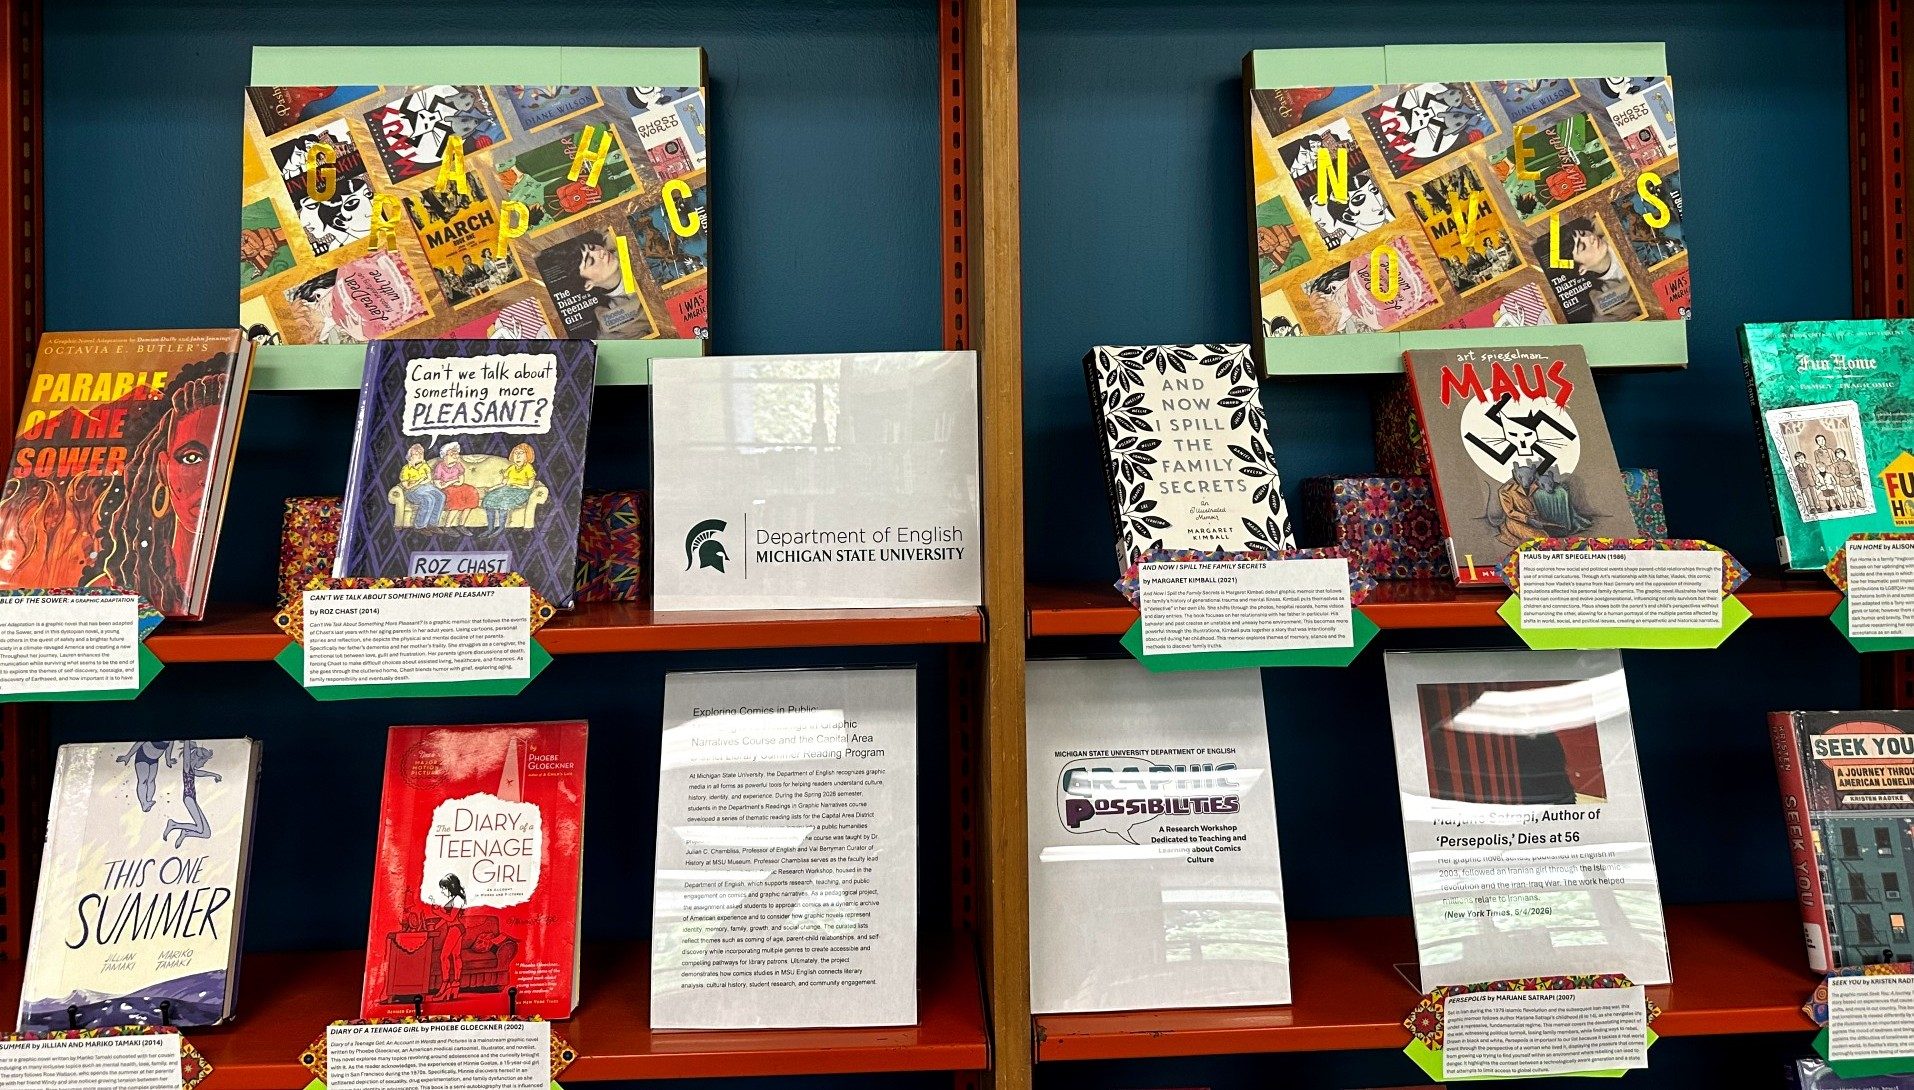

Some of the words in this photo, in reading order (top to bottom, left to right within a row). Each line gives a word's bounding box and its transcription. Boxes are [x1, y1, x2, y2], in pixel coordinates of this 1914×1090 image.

[637, 113, 676, 133] GHOST
[640, 120, 679, 139] WORLD
[425, 209, 495, 249] MARCH
[553, 288, 571, 301] The
[558, 295, 582, 310] Diary
[560, 296, 599, 317] Teenage
[564, 313, 583, 326] Girl
[44, 345, 109, 355] OCTAVIA
[115, 344, 129, 354] E.
[137, 343, 209, 353] BUTLER'S
[1456, 350, 1475, 362] art
[1480, 348, 1549, 362] spiegelman
[1795, 353, 1831, 373] Fun
[1830, 353, 1878, 373] Home
[411, 362, 453, 381] Can't
[458, 371, 476, 380] we
[481, 361, 510, 380] talk
[514, 361, 553, 380] about
[31, 371, 169, 403] PARABLE
[1161, 378, 1205, 391] AND
[1440, 359, 1575, 409] MAUS
[413, 382, 489, 401] something
[499, 385, 535, 397] more
[1161, 398, 1211, 411] NOW
[411, 397, 548, 427] PLEASANT?
[22, 409, 66, 440] OF
[70, 408, 128, 440] THE
[1156, 419, 1161, 432] I
[1170, 418, 1225, 431] SPILL
[1173, 438, 1213, 452] THE
[13, 446, 128, 479] SOWER
[1162, 458, 1234, 474] FAMILY
[1159, 479, 1247, 495] SECRETS
[756, 529, 867, 548] Department
[872, 526, 891, 544] of
[898, 525, 963, 545] English
[1883, 543, 1891, 551] by
[756, 549, 833, 564] MICHIGAN
[836, 548, 876, 562] STATE
[880, 547, 965, 562] UNIVERSITY
[1542, 553, 1551, 561] by
[414, 557, 453, 575] ROZ
[457, 557, 506, 574] CHAST
[1142, 563, 1157, 571] AND
[1237, 562, 1267, 570] SECRETS
[1142, 578, 1151, 586] by
[1217, 576, 1238, 584] (2021)
[387, 592, 431, 600] SOMETHING
[454, 590, 495, 598] PLEASANT?
[309, 608, 319, 616] by
[358, 607, 380, 616] (2014)
[851, 733, 874, 743] Area
[1054, 750, 1088, 758] MICHIGAN
[1110, 749, 1150, 757] UNIVERSITY
[1150, 748, 1195, 756] DEPARTMENT
[1814, 737, 1869, 757] SEEK
[1871, 736, 1914, 756] YOU
[527, 754, 560, 762] PHOEBE
[845, 748, 885, 760] Program
[527, 761, 575, 770] GLOECKNER
[1837, 768, 1844, 777] A
[1845, 767, 1885, 777] JOURNEY
[1839, 778, 1880, 787] AMERICAN
[436, 824, 451, 833] The
[454, 808, 523, 833] DIARY
[1541, 810, 1586, 822] Author
[1588, 808, 1601, 820] of
[1165, 825, 1200, 833] Research
[1200, 824, 1238, 833] Workshop
[1151, 835, 1189, 844] Dedicated
[1199, 835, 1232, 844] Teaching
[1232, 834, 1247, 842] and
[1517, 832, 1547, 844] Dies
[1549, 833, 1563, 844] at
[1564, 831, 1580, 843] 56
[434, 834, 534, 859] TEENAGE
[1191, 845, 1214, 853] about
[1214, 844, 1242, 853] Comics
[1186, 856, 1215, 864] Culture
[104, 858, 156, 891] THIS
[159, 855, 209, 886] ONE
[472, 859, 527, 884] GIRL
[64, 886, 232, 950] SUMMER
[104, 952, 137, 963] JILLIAN
[157, 949, 194, 960] MARIKO
[99, 962, 136, 974] TAMAKI
[155, 958, 193, 971] TAMAKI
[1448, 995, 1487, 1004] PERSEPOLIS
[1487, 994, 1496, 1002] by
[1496, 993, 1527, 1001] MARJANE
[1527, 993, 1555, 1001] SATRAPI
[1556, 993, 1576, 1001] (2007)
[330, 1027, 352, 1035] DIARY
[352, 1027, 363, 1035] OF
[370, 1026, 402, 1034] TEENAGE
[420, 1026, 430, 1034] by
[460, 1024, 503, 1032] GLOECKNER
[503, 1023, 525, 1032] (2002)
[142, 1039, 163, 1047] (2014)
